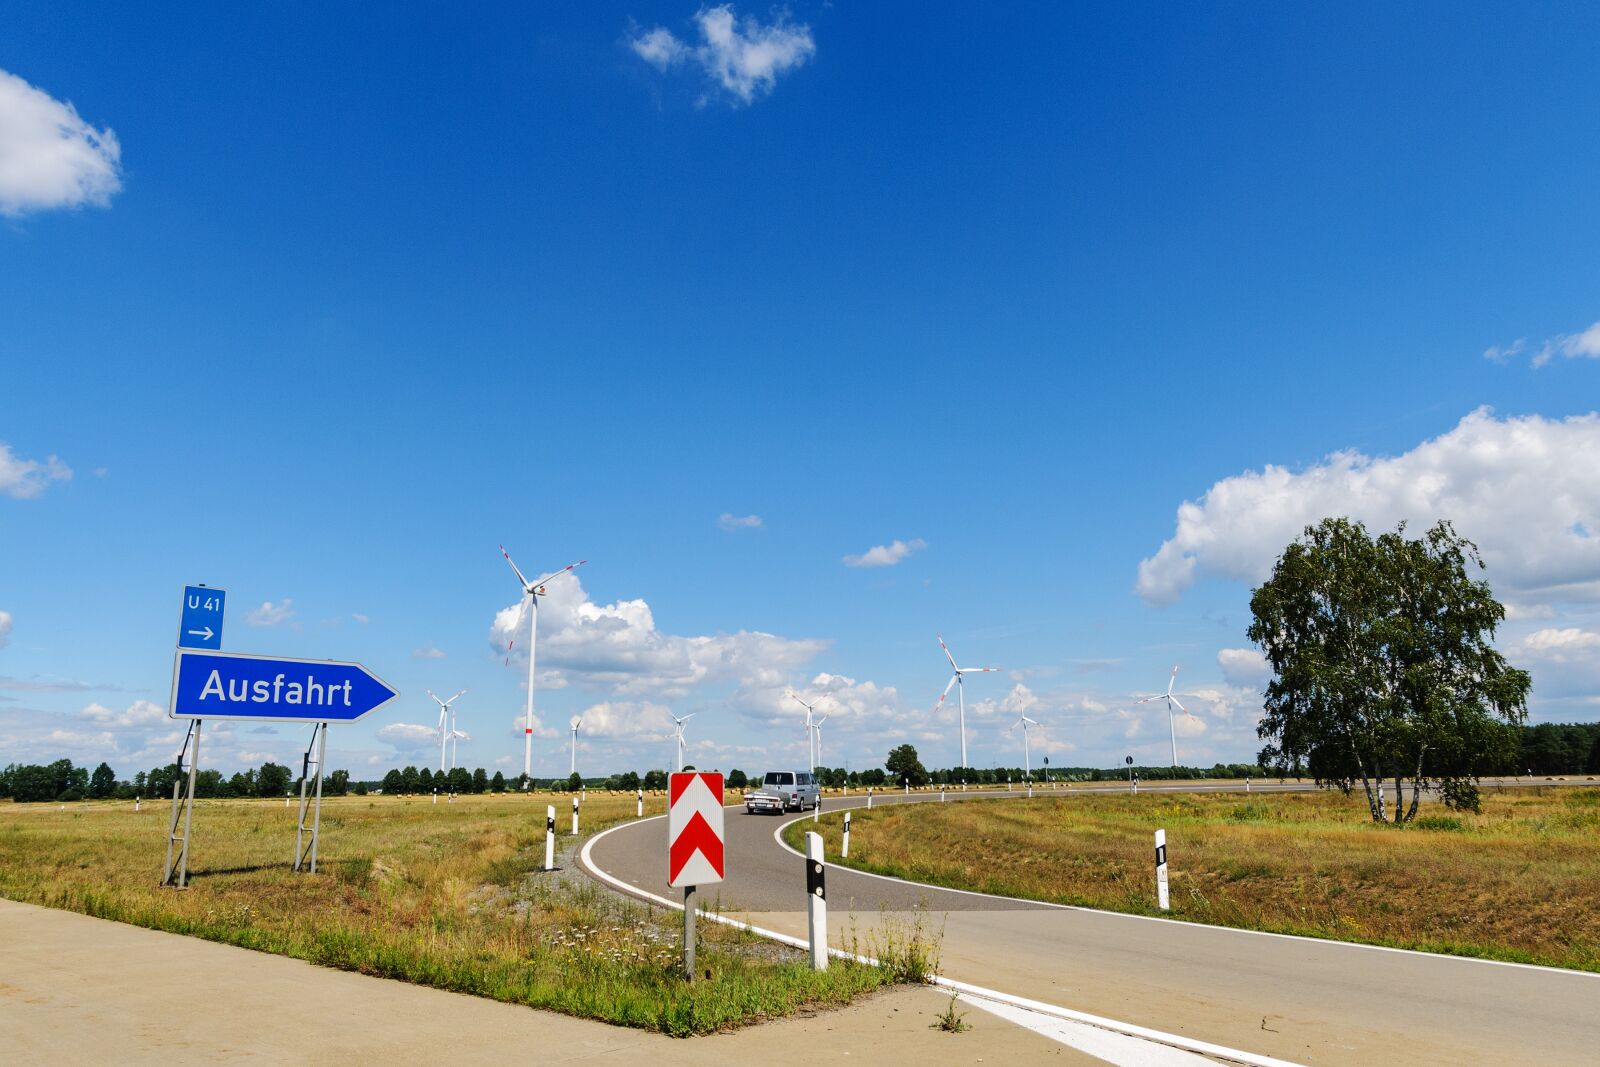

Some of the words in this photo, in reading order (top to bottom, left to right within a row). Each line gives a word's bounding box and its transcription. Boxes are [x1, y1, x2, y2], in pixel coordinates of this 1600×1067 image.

[188, 595, 200, 610] U
[204, 597, 220, 612] 41
[199, 669, 353, 706] Ausfahrt
